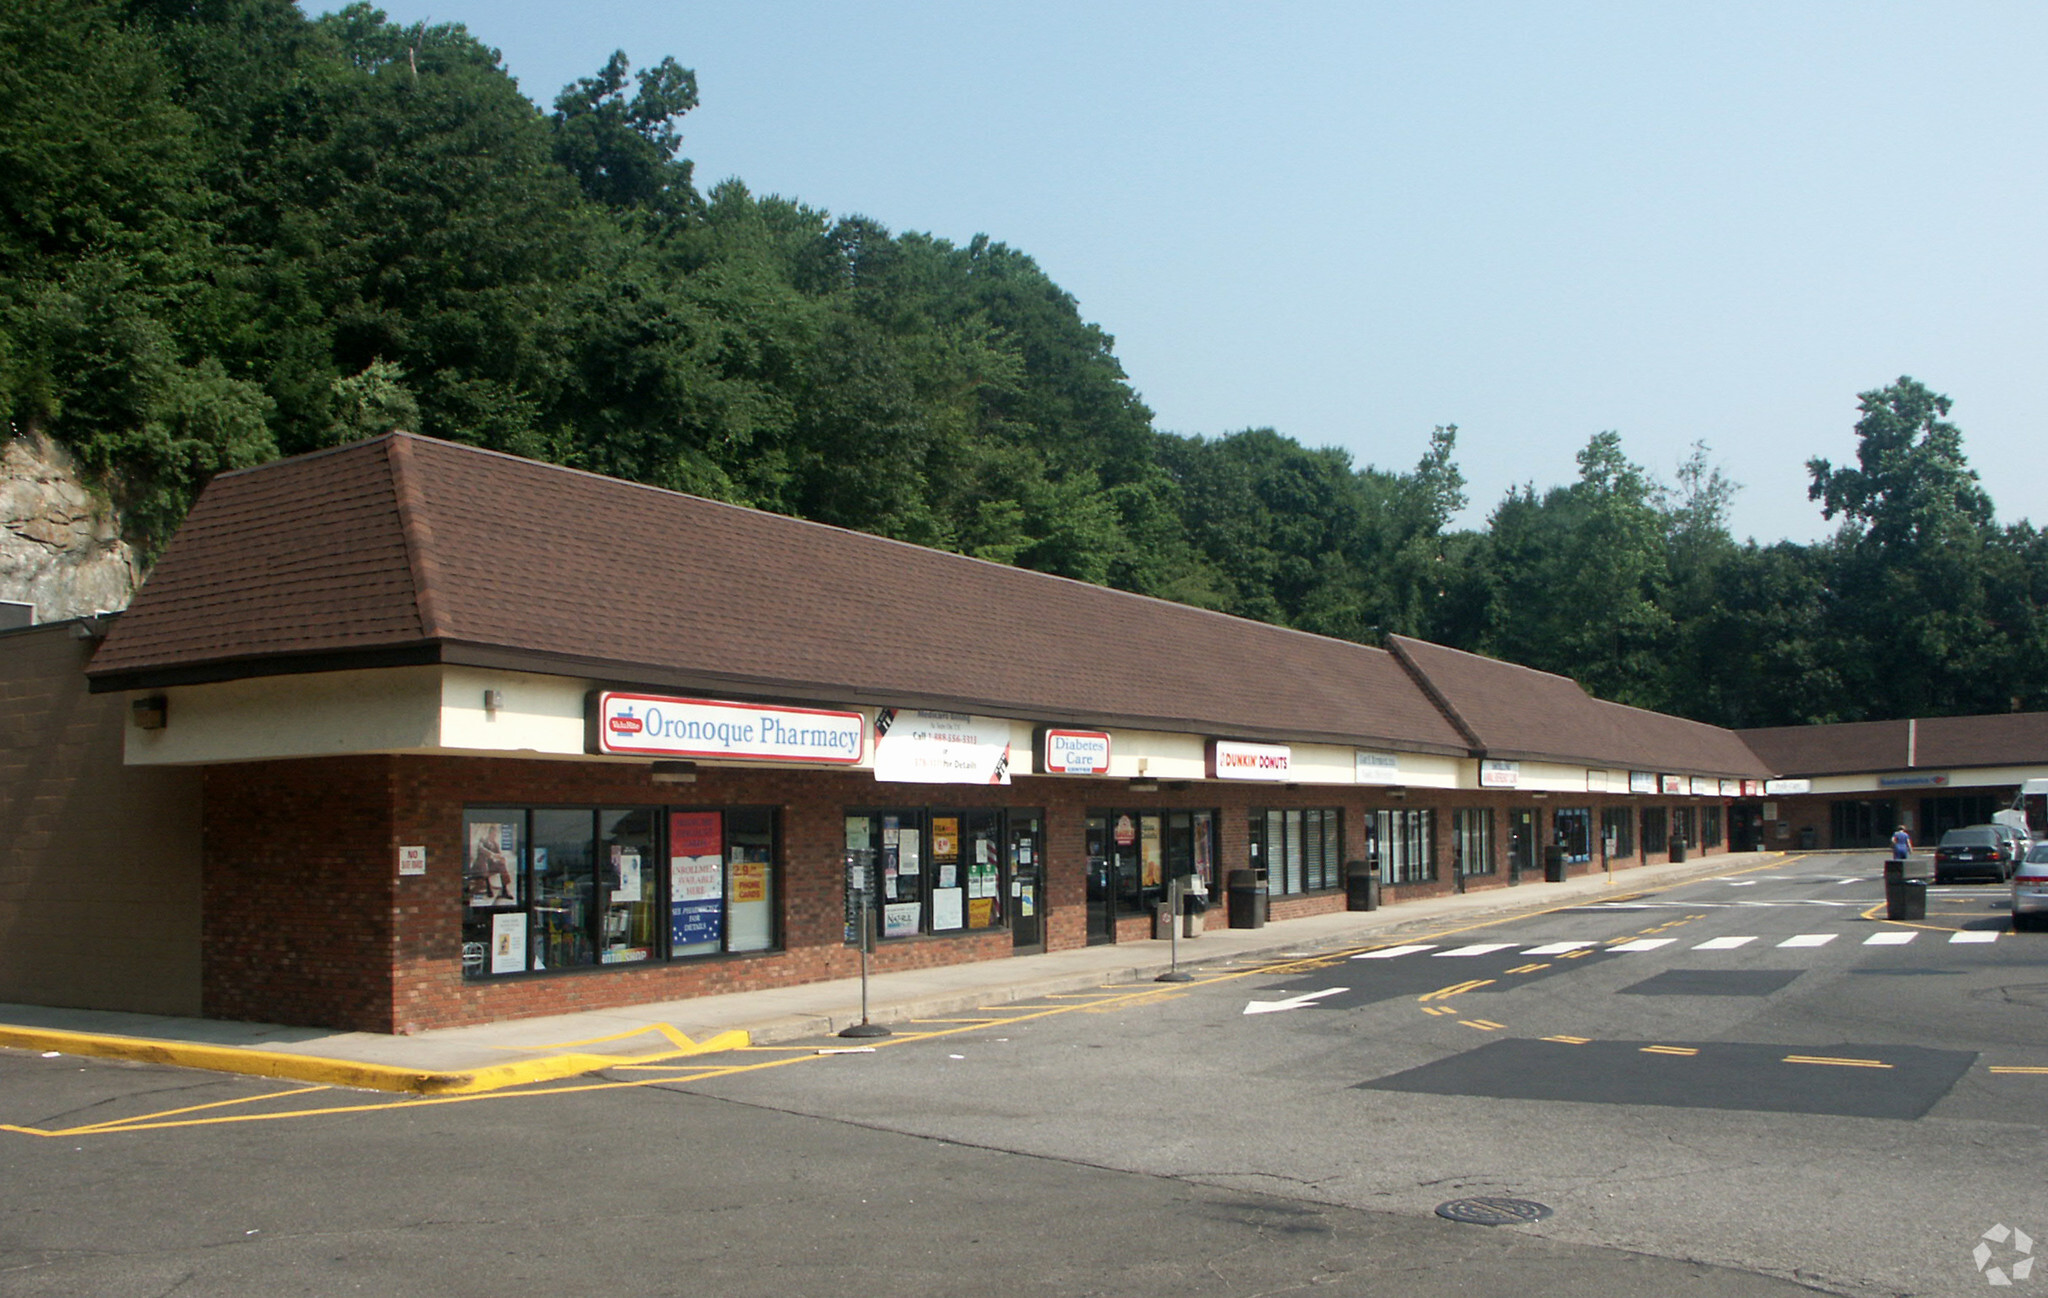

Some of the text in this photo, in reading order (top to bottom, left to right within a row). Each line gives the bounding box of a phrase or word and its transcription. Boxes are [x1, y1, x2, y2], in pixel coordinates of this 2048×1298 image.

[645, 707, 753, 747] Oronoque
[760, 717, 858, 753] Pharmacy
[1055, 737, 1104, 751] Diabetes
[1066, 751, 1093, 765] Care
[1225, 752, 1288, 770] DUNKIN' DONUTS
[407, 850, 418, 859] NO
[686, 885, 705, 896] HERE
[625, 950, 647, 962] SHOP
